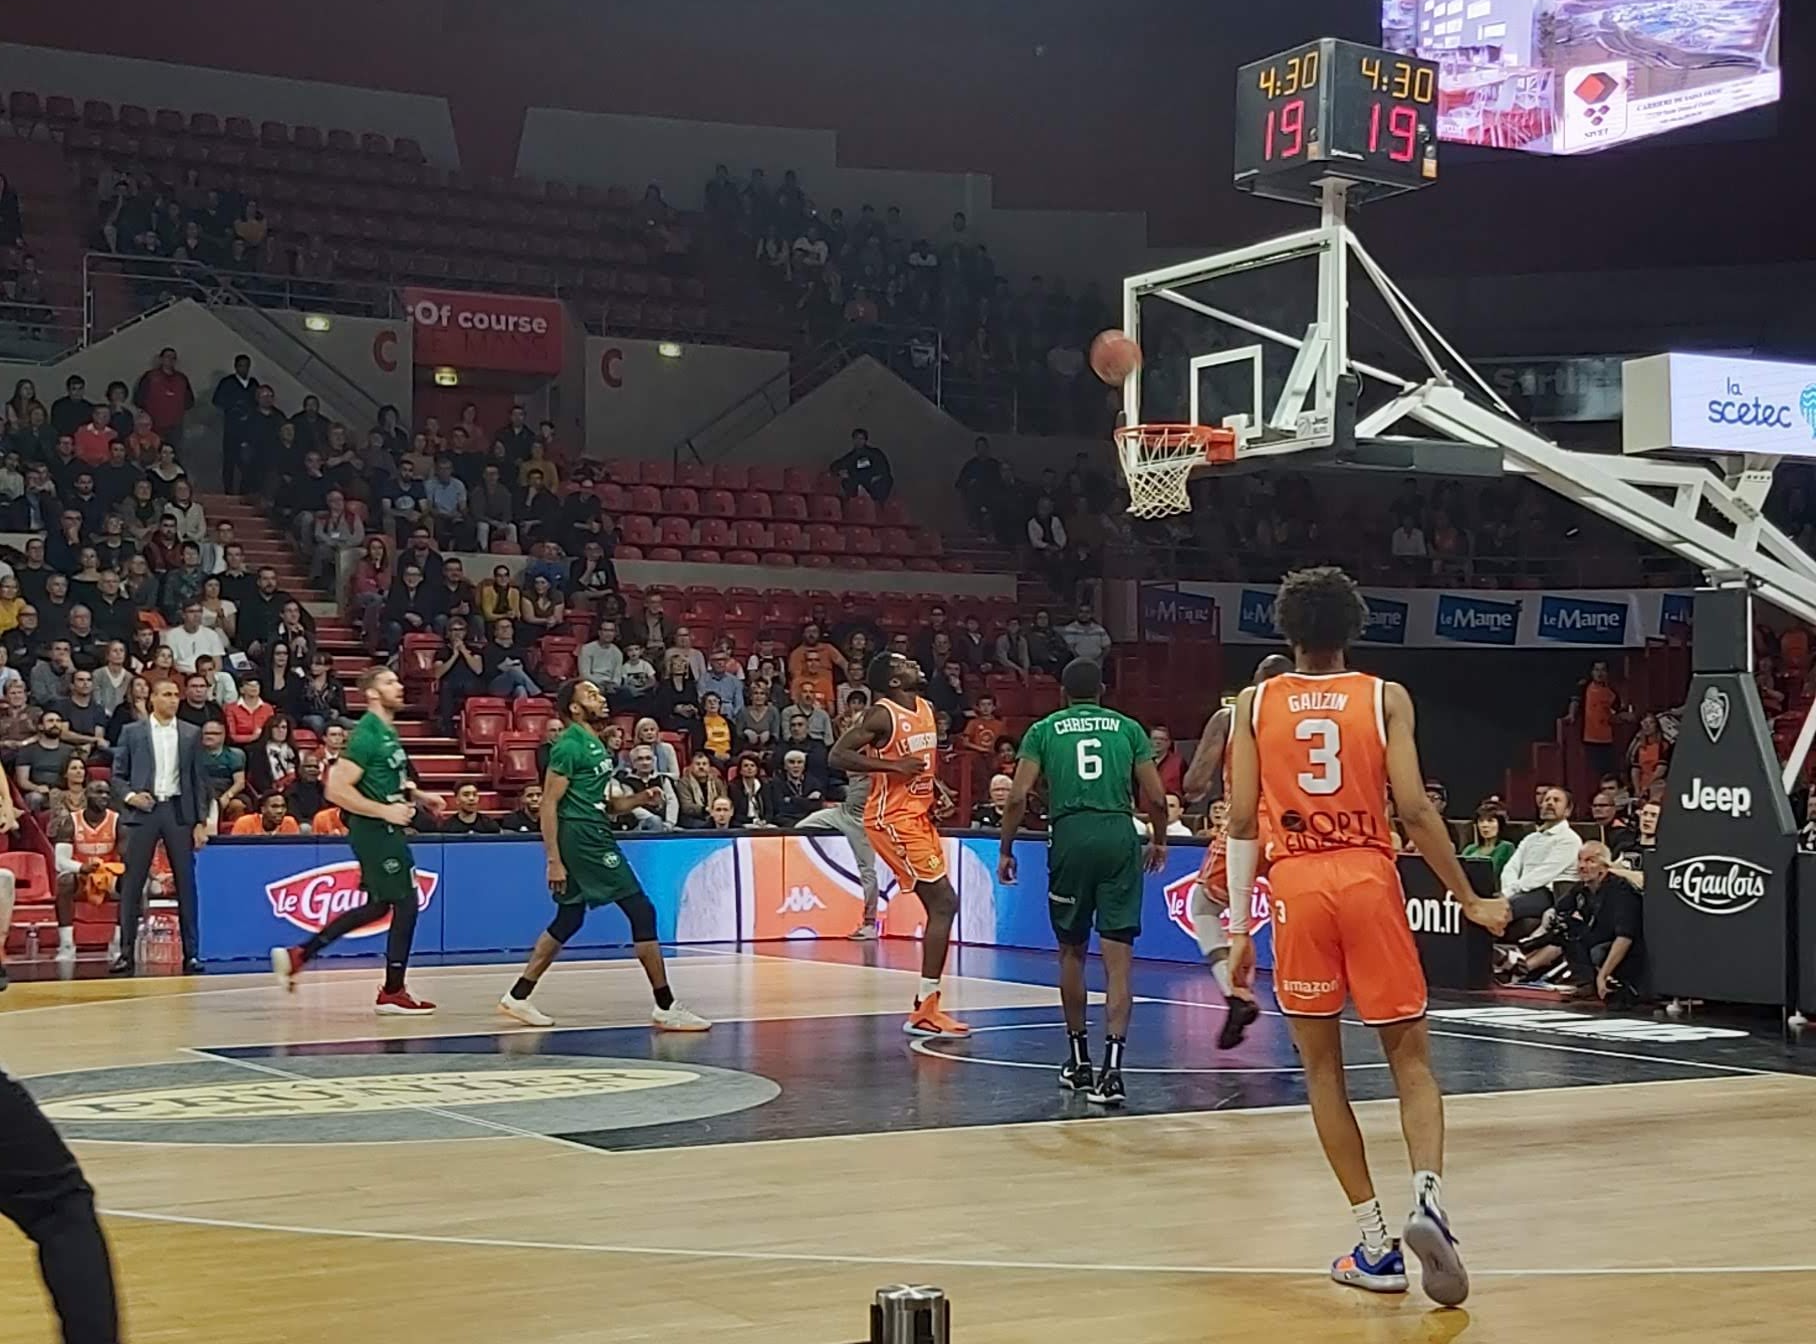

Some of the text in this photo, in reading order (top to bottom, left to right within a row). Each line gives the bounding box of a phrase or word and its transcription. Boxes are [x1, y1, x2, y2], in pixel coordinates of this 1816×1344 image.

[1259, 51, 1319, 99] 4:30
[1361, 57, 1433, 103] 4:30
[1265, 100, 1304, 160] 19
[1369, 103, 1418, 162] 19
[457, 309, 548, 334] course
[373, 330, 398, 372] C
[601, 347, 623, 387] C
[1727, 377, 1742, 396] la
[1708, 396, 1792, 428] scetec
[1543, 612, 1556, 626] Le
[1287, 692, 1349, 713] GAUZIN
[1054, 717, 1120, 735] CHRISTON
[1076, 738, 1103, 780] 6
[1295, 718, 1344, 796] 3
[1681, 777, 1752, 817] Jeep
[1310, 810, 1377, 836] OPTI
[278, 888, 298, 912] le
[1668, 862, 1765, 904] le Gaulois
[1171, 891, 1184, 916] le
[1275, 899, 1287, 923] 3
[1283, 979, 1339, 993] amazon
[68, 1070, 668, 1114] PRUNIER
